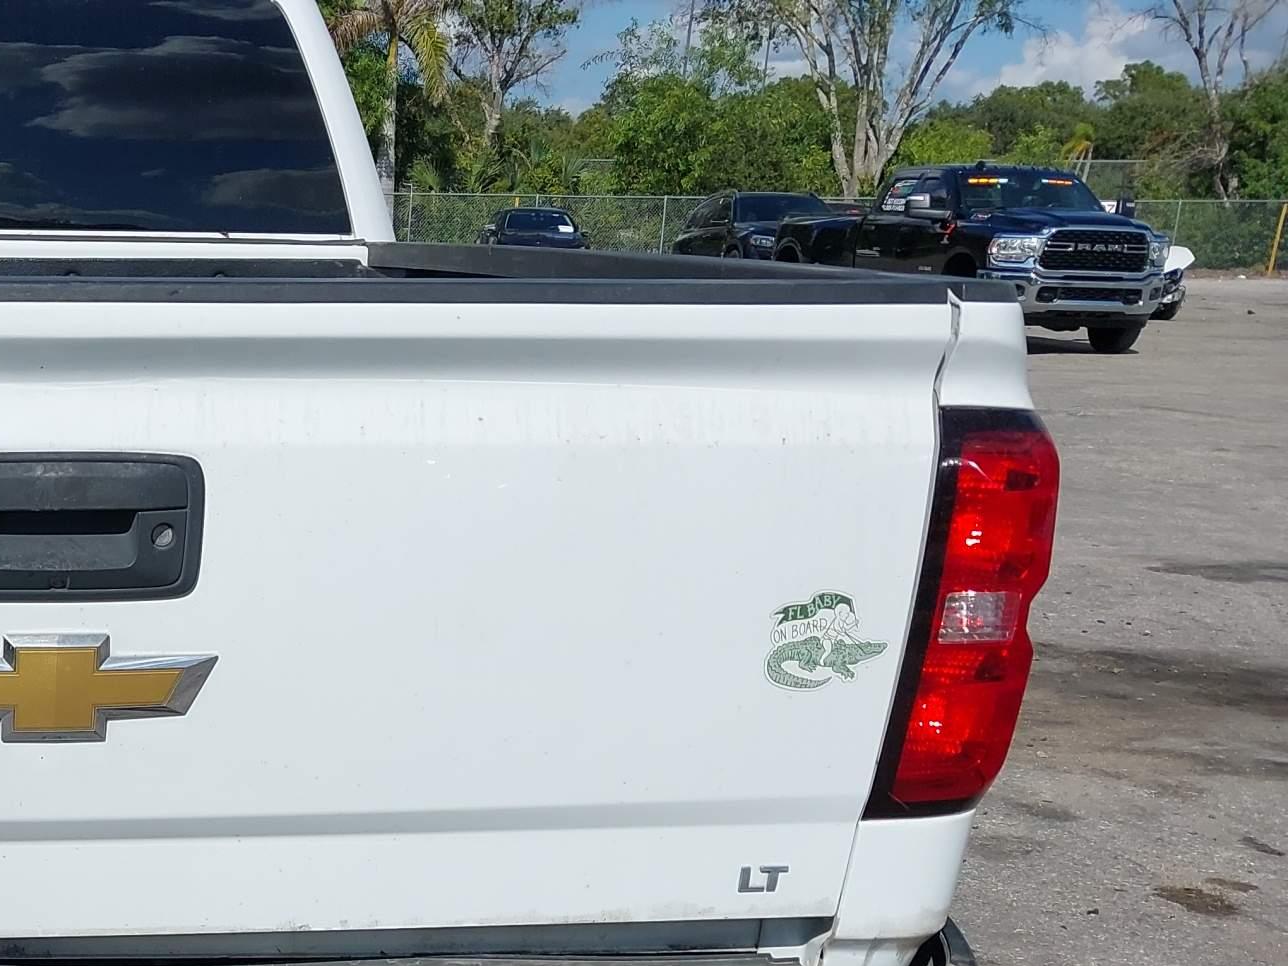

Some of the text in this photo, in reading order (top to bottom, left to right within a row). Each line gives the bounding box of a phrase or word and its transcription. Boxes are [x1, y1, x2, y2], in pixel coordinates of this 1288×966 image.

[788, 595, 841, 621] FL BABY
[773, 617, 828, 643] ON BOARD
[738, 866, 789, 892] LT
